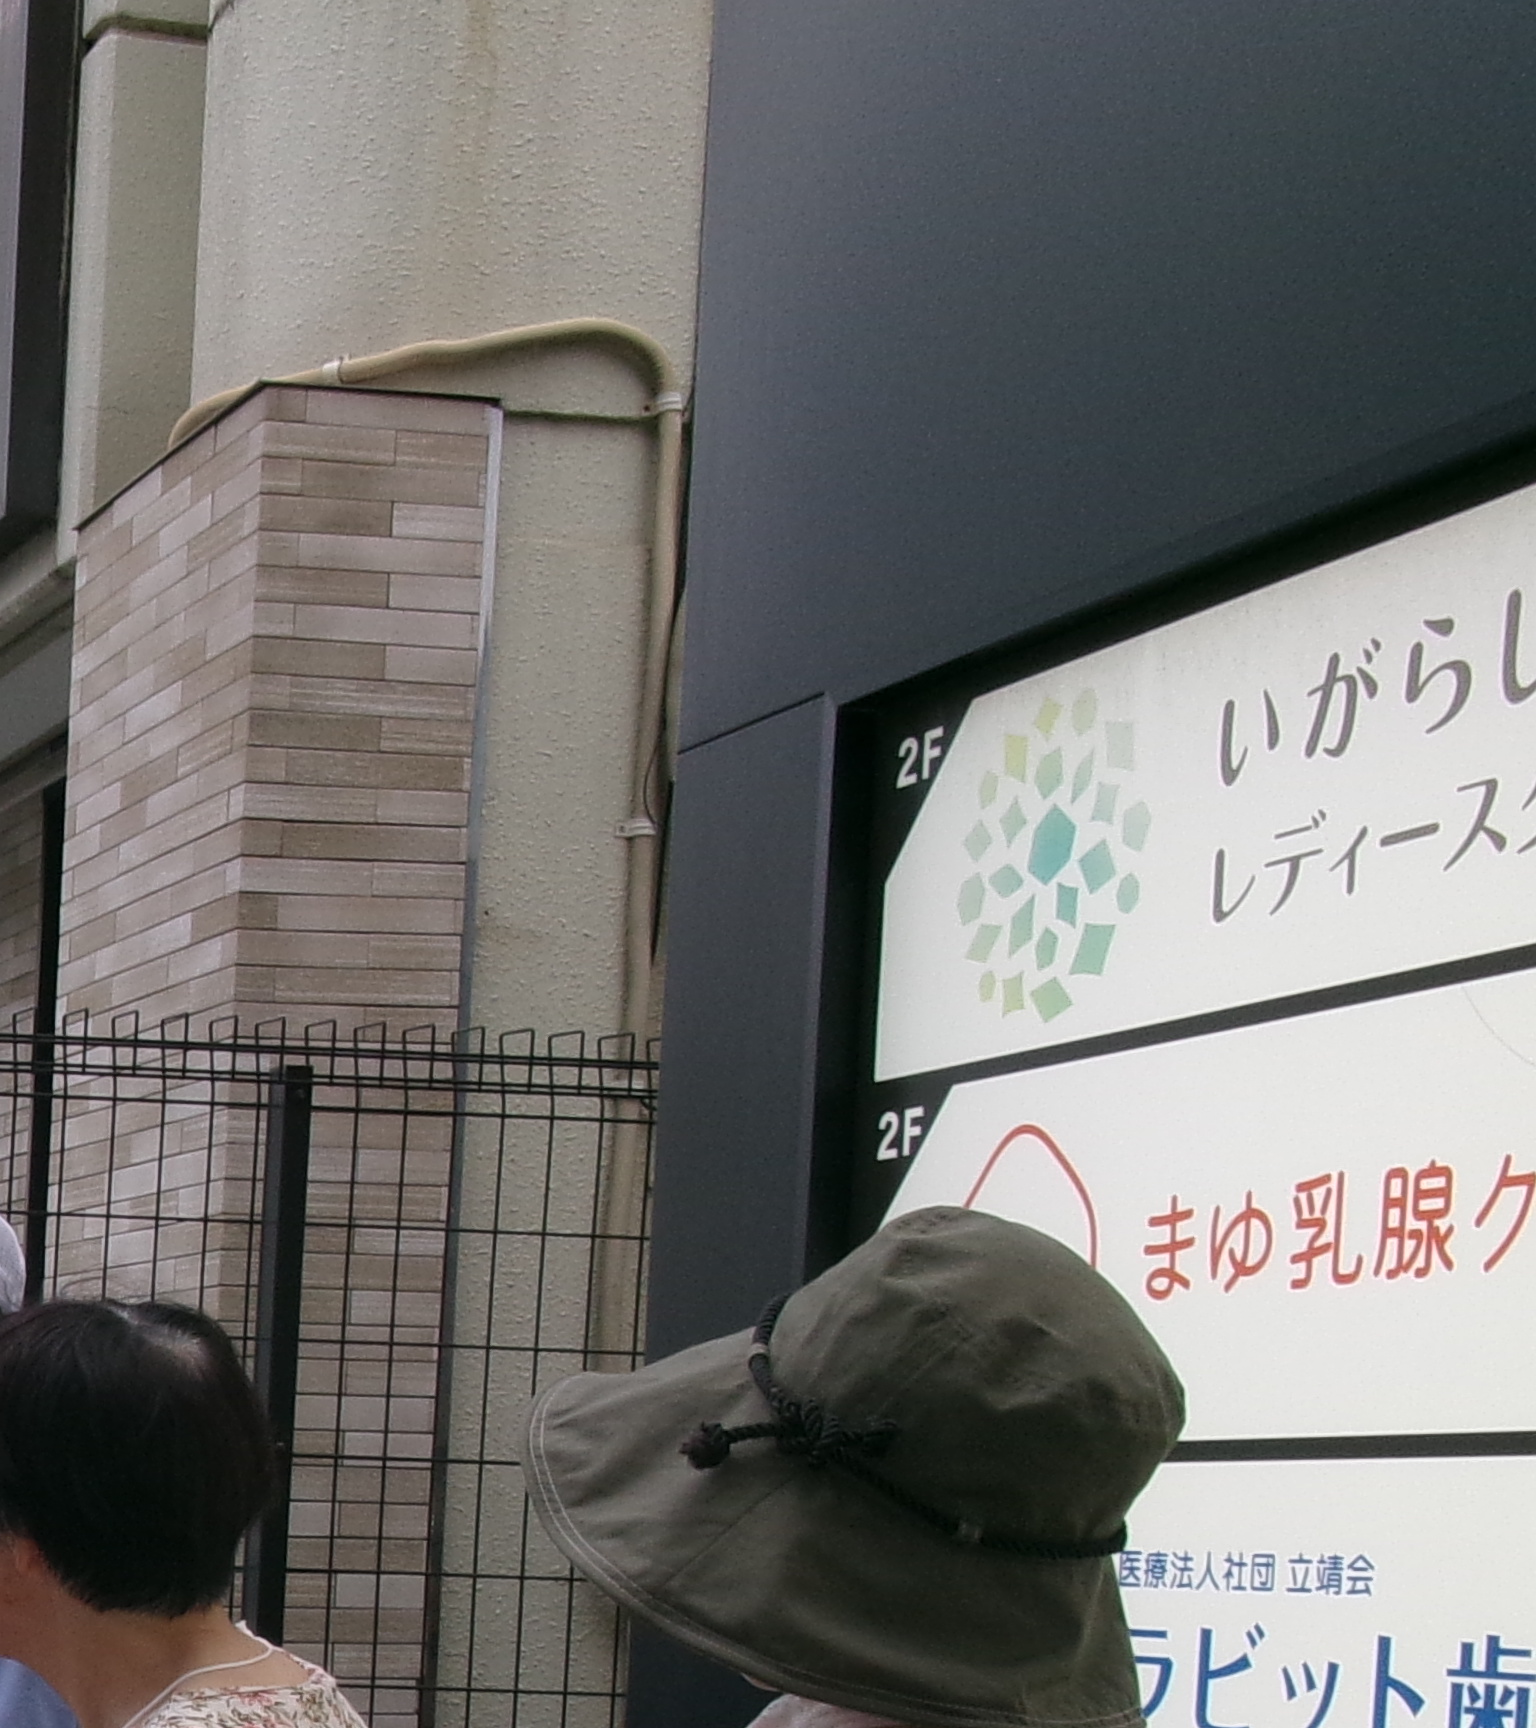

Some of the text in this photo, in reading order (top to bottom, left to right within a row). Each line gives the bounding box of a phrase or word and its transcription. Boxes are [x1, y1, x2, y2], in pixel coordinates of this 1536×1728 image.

[1219, 588, 1536, 787] いがらし
[896, 726, 945, 789] 2F
[1211, 777, 1536, 924] レディース
[876, 1106, 925, 1161] 2F
[1143, 1154, 1536, 1301] まゆ乳腺ク
[1118, 1550, 1376, 1597] 医療法人社団 立靖会
